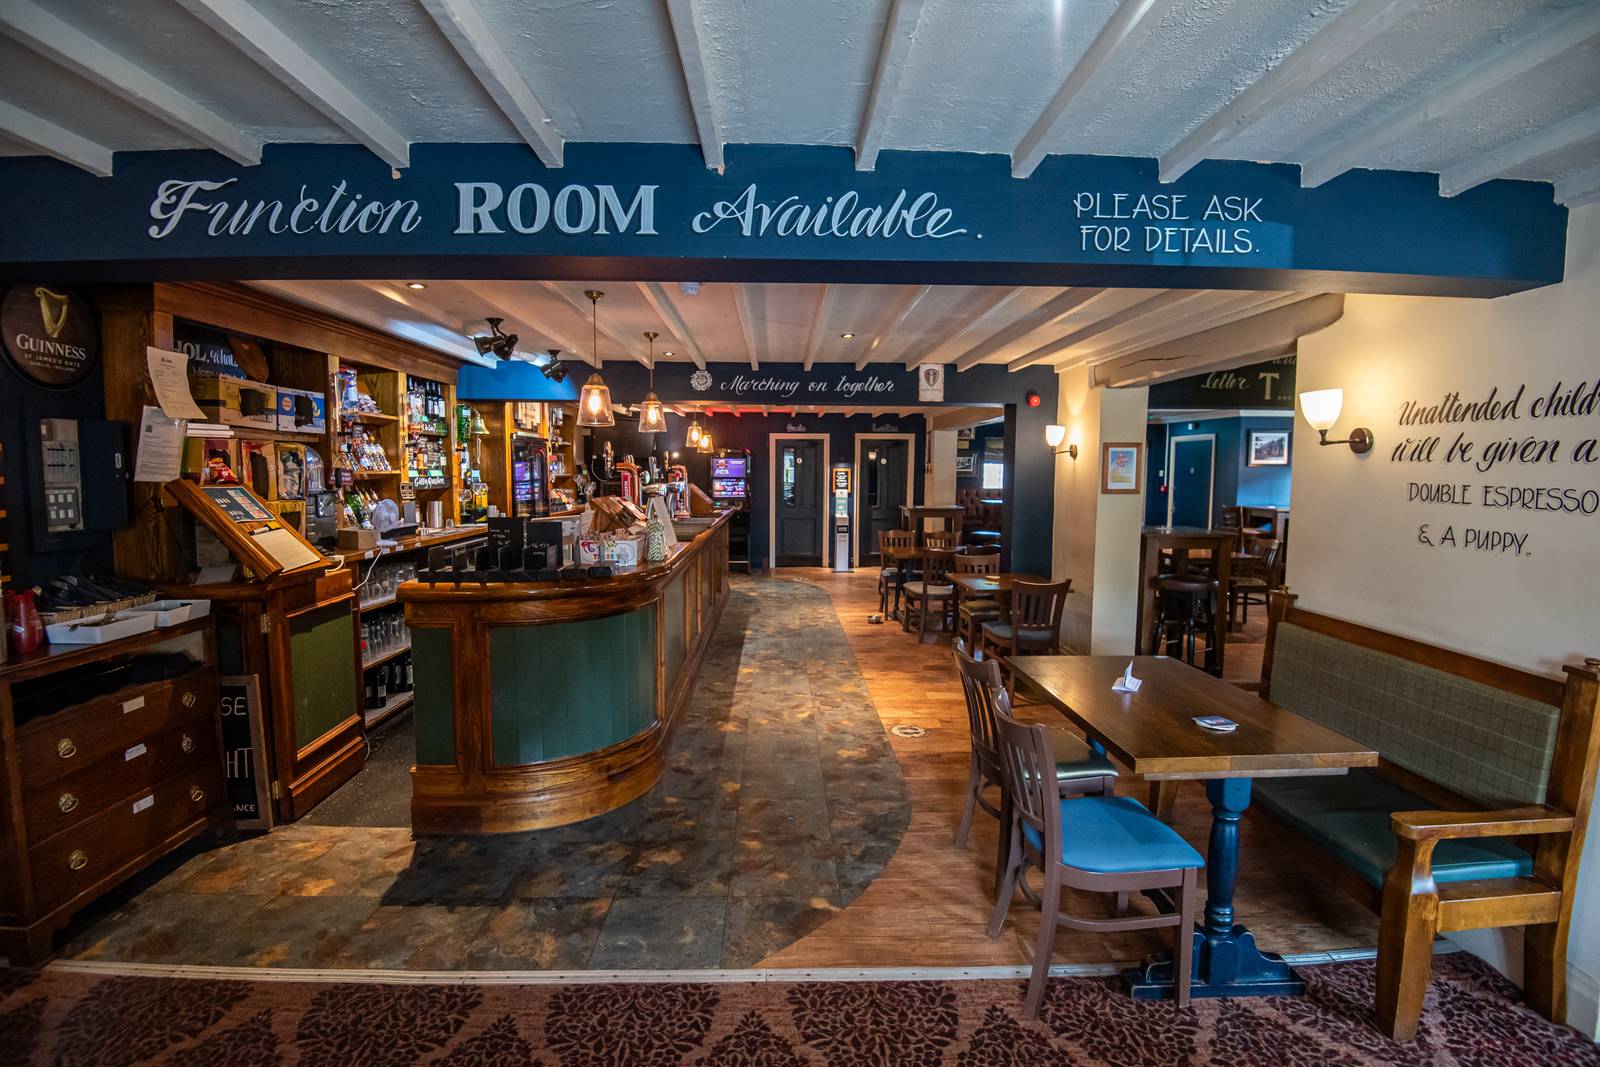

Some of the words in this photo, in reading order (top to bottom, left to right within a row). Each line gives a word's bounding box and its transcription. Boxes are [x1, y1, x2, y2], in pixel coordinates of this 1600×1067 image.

[149, 177, 422, 239] Function
[453, 182, 661, 235] ROOM
[1073, 192, 1190, 220] PLEASE
[1203, 195, 1263, 222] ASK
[1080, 225, 1131, 251] FOR
[1144, 226, 1260, 253] DETAILS.
[16, 333, 87, 361] GUINNESS
[720, 374, 800, 398] Marching
[807, 383, 828, 392] on
[834, 375, 894, 398] together
[1400, 383, 1526, 426] Unattended
[1391, 436, 1441, 463] will
[1446, 432, 1474, 463] be
[1476, 436, 1561, 473] given
[1573, 438, 1600, 462] a
[1408, 482, 1473, 505] DOUBLE
[1483, 485, 1600, 514] ESPRESSO
[1418, 524, 1435, 547] &
[1441, 526, 1457, 547] A
[1464, 528, 1532, 556] PUPPY.
